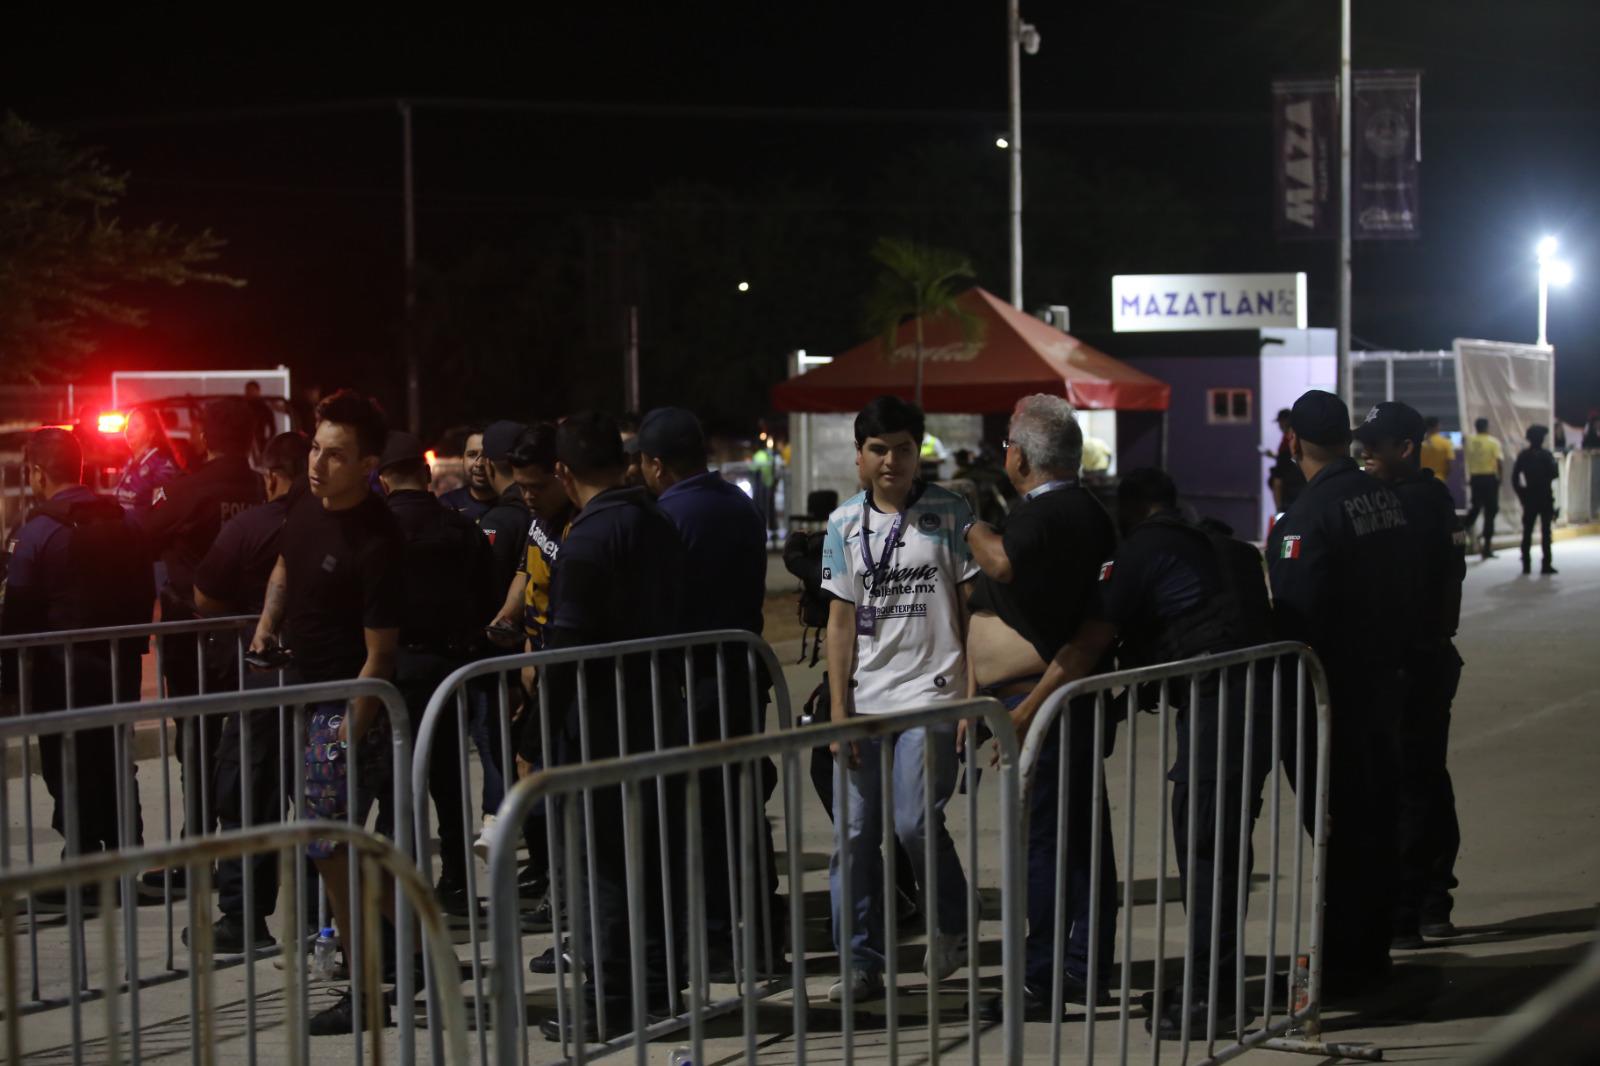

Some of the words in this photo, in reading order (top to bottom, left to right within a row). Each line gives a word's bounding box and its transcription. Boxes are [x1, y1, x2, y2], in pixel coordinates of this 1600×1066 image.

[1285, 100, 1315, 229] MAZA
[869, 583, 936, 598] aliente.mx
[876, 603, 927, 615] RQUETEXPRESS
